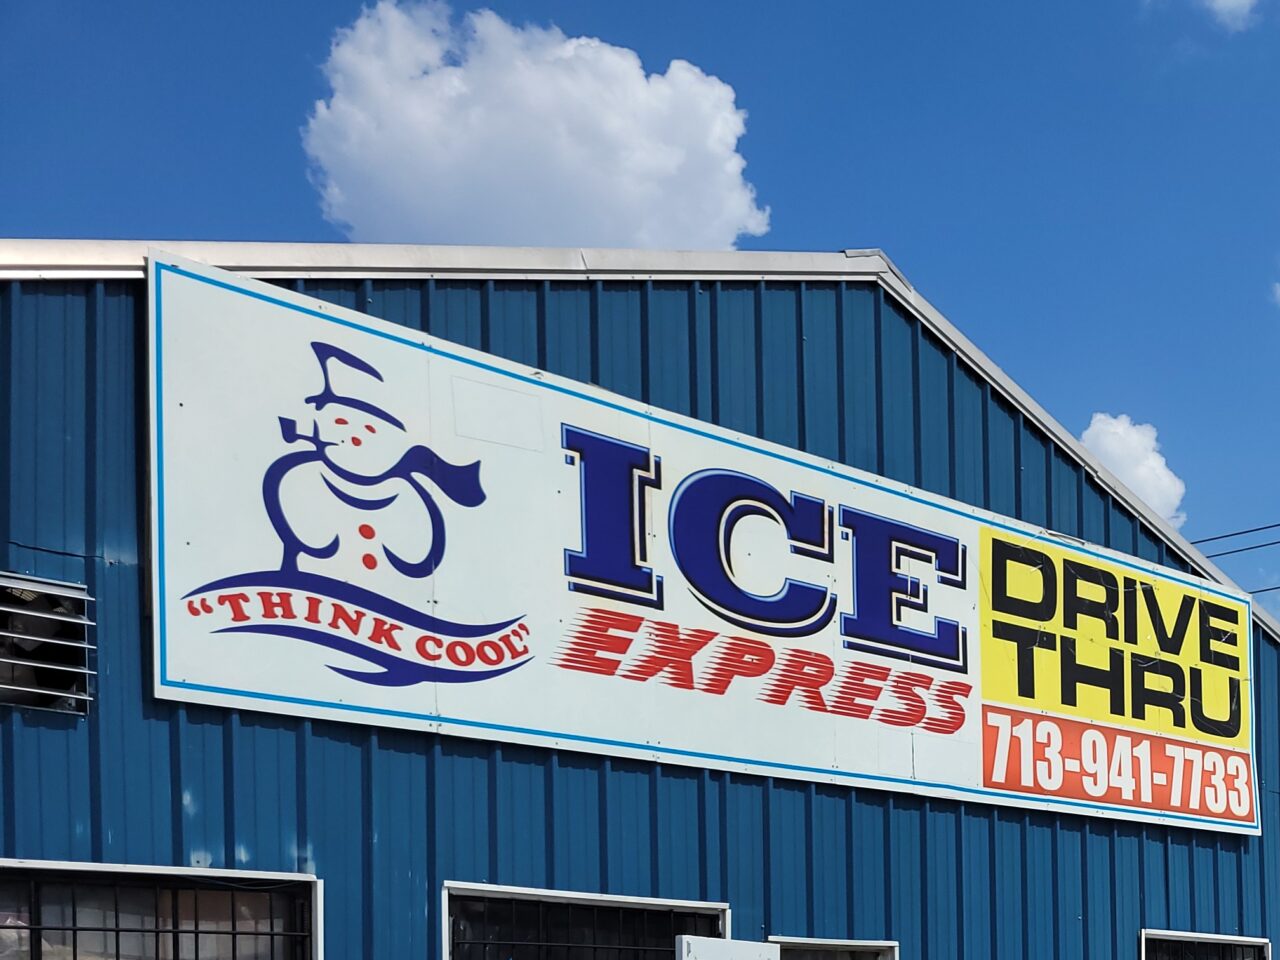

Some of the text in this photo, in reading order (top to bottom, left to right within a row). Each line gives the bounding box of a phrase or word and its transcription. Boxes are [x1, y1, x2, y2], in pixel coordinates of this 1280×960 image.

[561, 423, 968, 674] ICE
[992, 538, 1239, 671] DRIVE
[547, 606, 973, 735] EXPRESS
[992, 619, 1241, 738] THRU
[987, 712, 1250, 816] 713-941-7733
